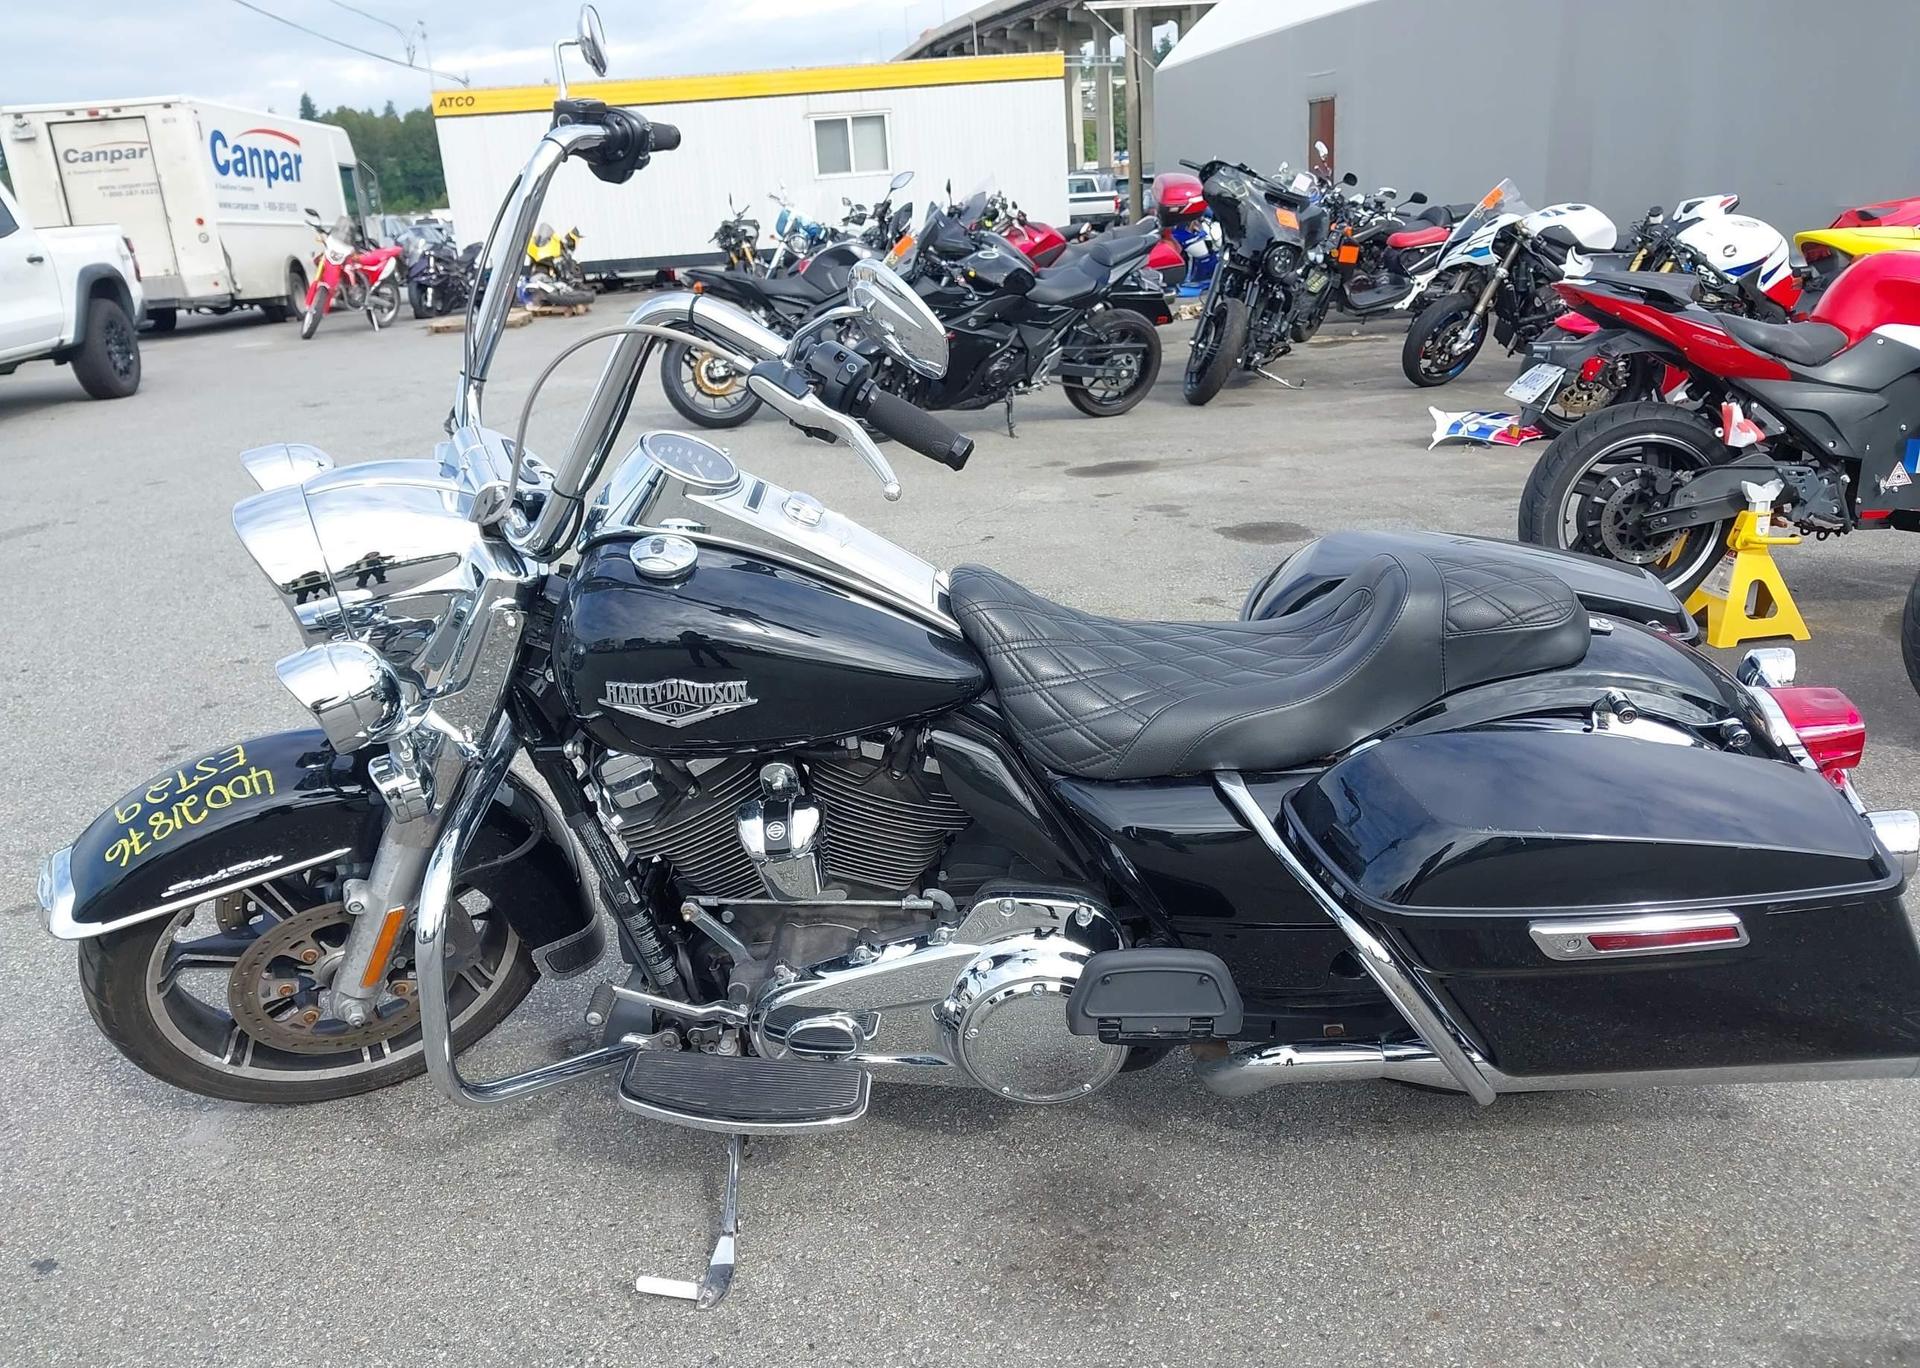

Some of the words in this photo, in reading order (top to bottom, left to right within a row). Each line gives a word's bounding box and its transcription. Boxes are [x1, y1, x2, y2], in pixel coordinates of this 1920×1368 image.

[439, 96, 475, 108] ATCO
[63, 147, 148, 163] Canpar
[210, 130, 302, 189] Canpar
[666, 704, 686, 713] USA
[105, 766, 274, 867] 40021876
